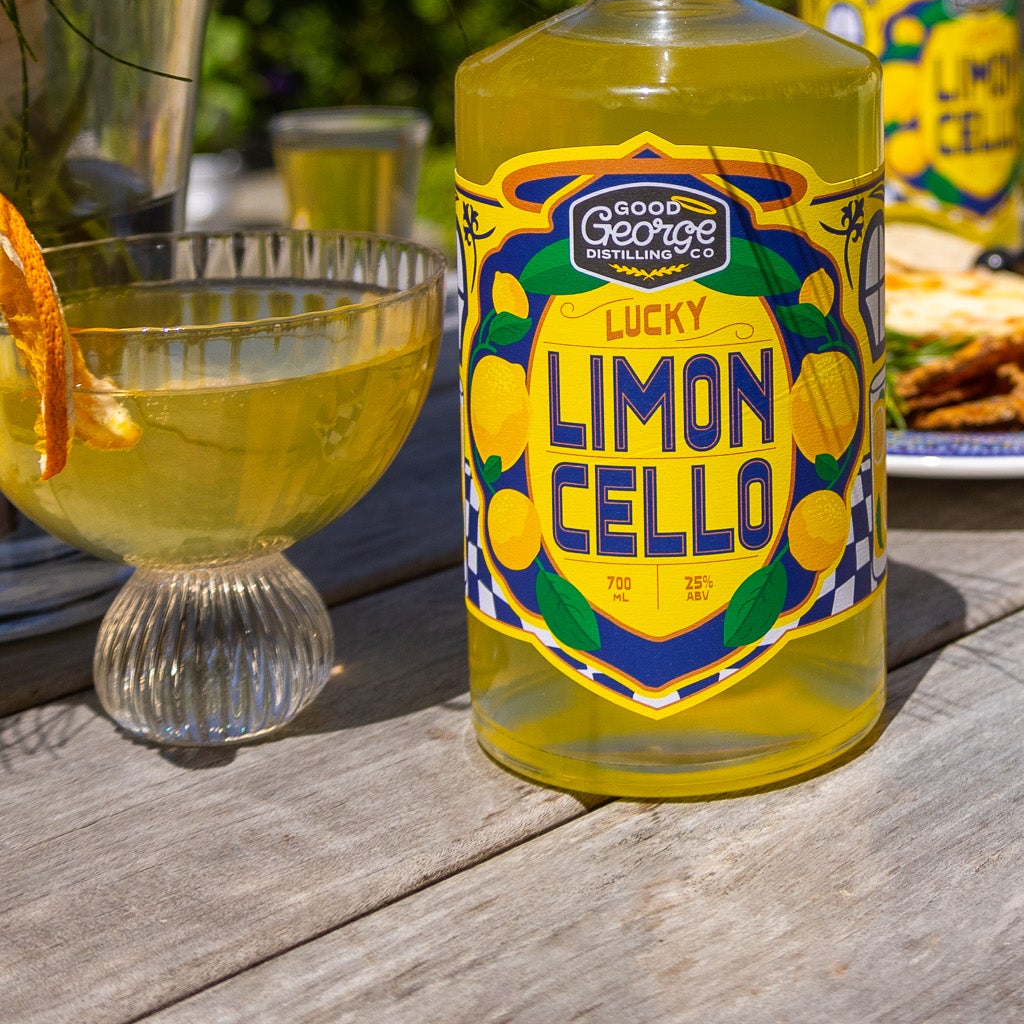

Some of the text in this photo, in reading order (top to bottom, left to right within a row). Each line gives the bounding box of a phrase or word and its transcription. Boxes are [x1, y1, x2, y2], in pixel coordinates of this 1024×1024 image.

[614, 200, 682, 216] GOOD
[581, 205, 717, 255] George
[586, 247, 715, 260] DISTILLING CO
[605, 295, 708, 342] LUCKY
[547, 347, 775, 453] LIMON
[551, 457, 774, 558] CELLO
[607, 575, 632, 591] 700
[684, 574, 714, 591] 25%
[613, 592, 630, 603] ML
[686, 590, 710, 602] ABV
